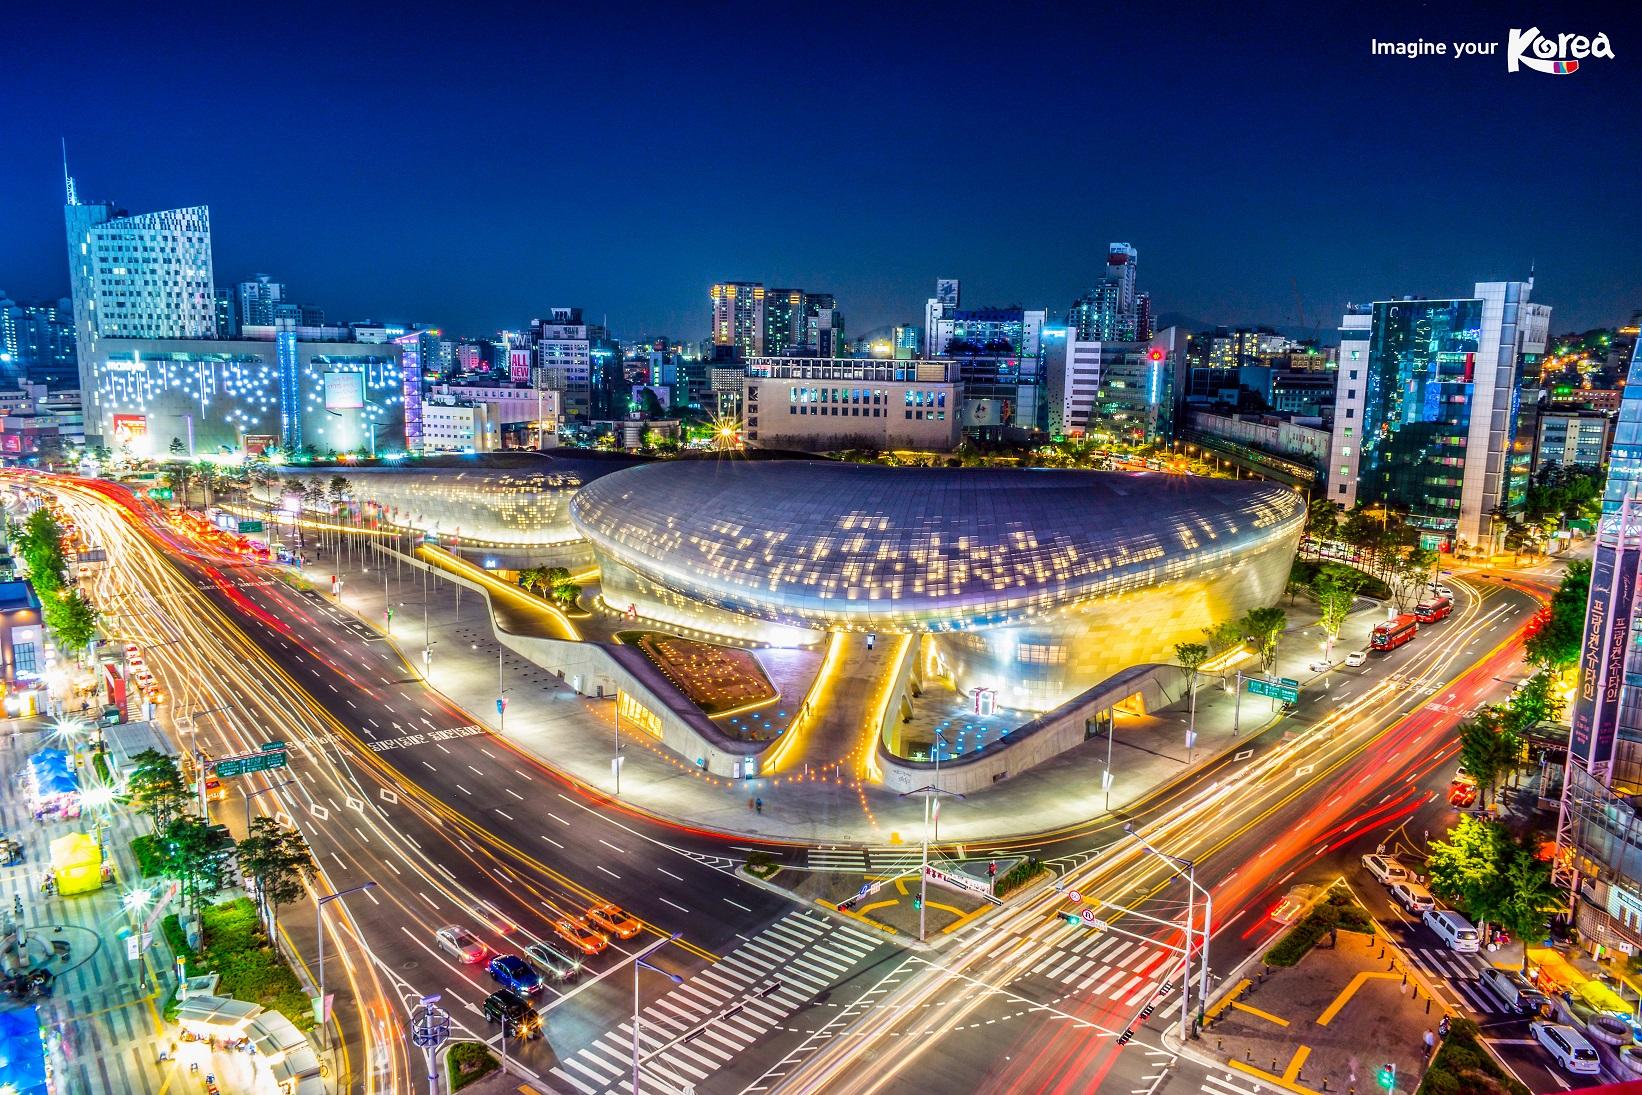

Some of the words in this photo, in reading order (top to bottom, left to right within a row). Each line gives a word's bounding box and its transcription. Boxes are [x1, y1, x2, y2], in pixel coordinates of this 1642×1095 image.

[512, 354, 528, 366] ALL
[512, 367, 528, 377] NEW
[1582, 599, 1605, 702] 프랑켄슈타인
[1606, 617, 1627, 703] 프랑켄슈타인
